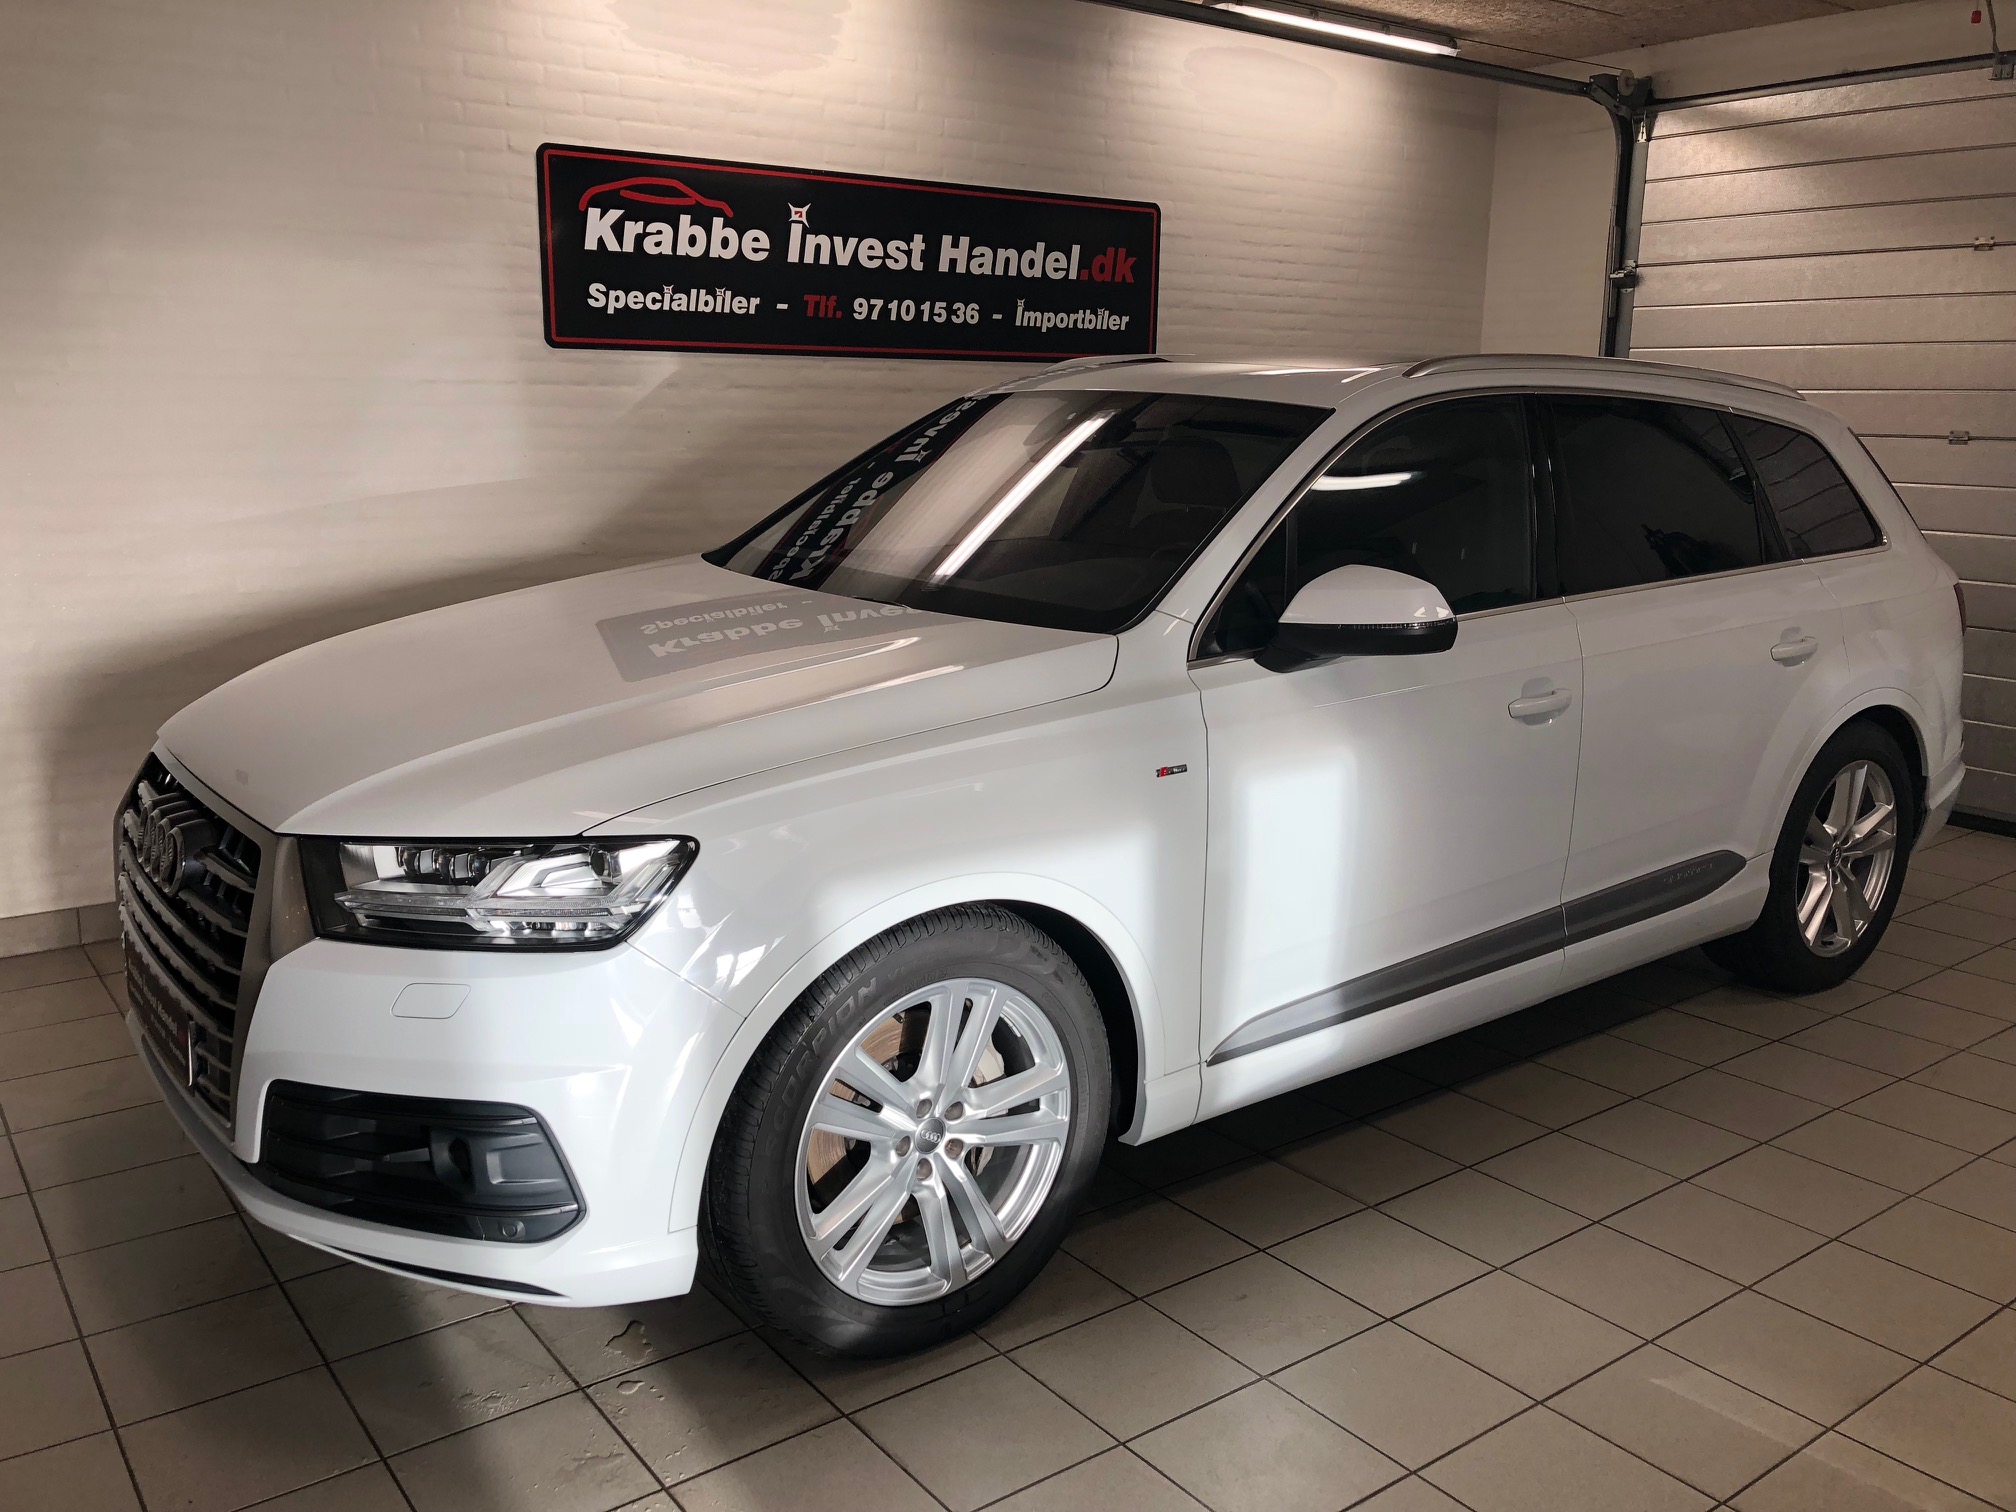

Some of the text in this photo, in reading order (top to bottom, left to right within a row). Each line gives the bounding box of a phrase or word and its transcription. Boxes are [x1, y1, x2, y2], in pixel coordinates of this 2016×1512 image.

[584, 202, 1137, 283] Krabbe Invest Handel.dk
[587, 283, 760, 315] Specialbiler
[804, 295, 842, 319] Tlf.
[1015, 299, 1130, 332] Importbiler
